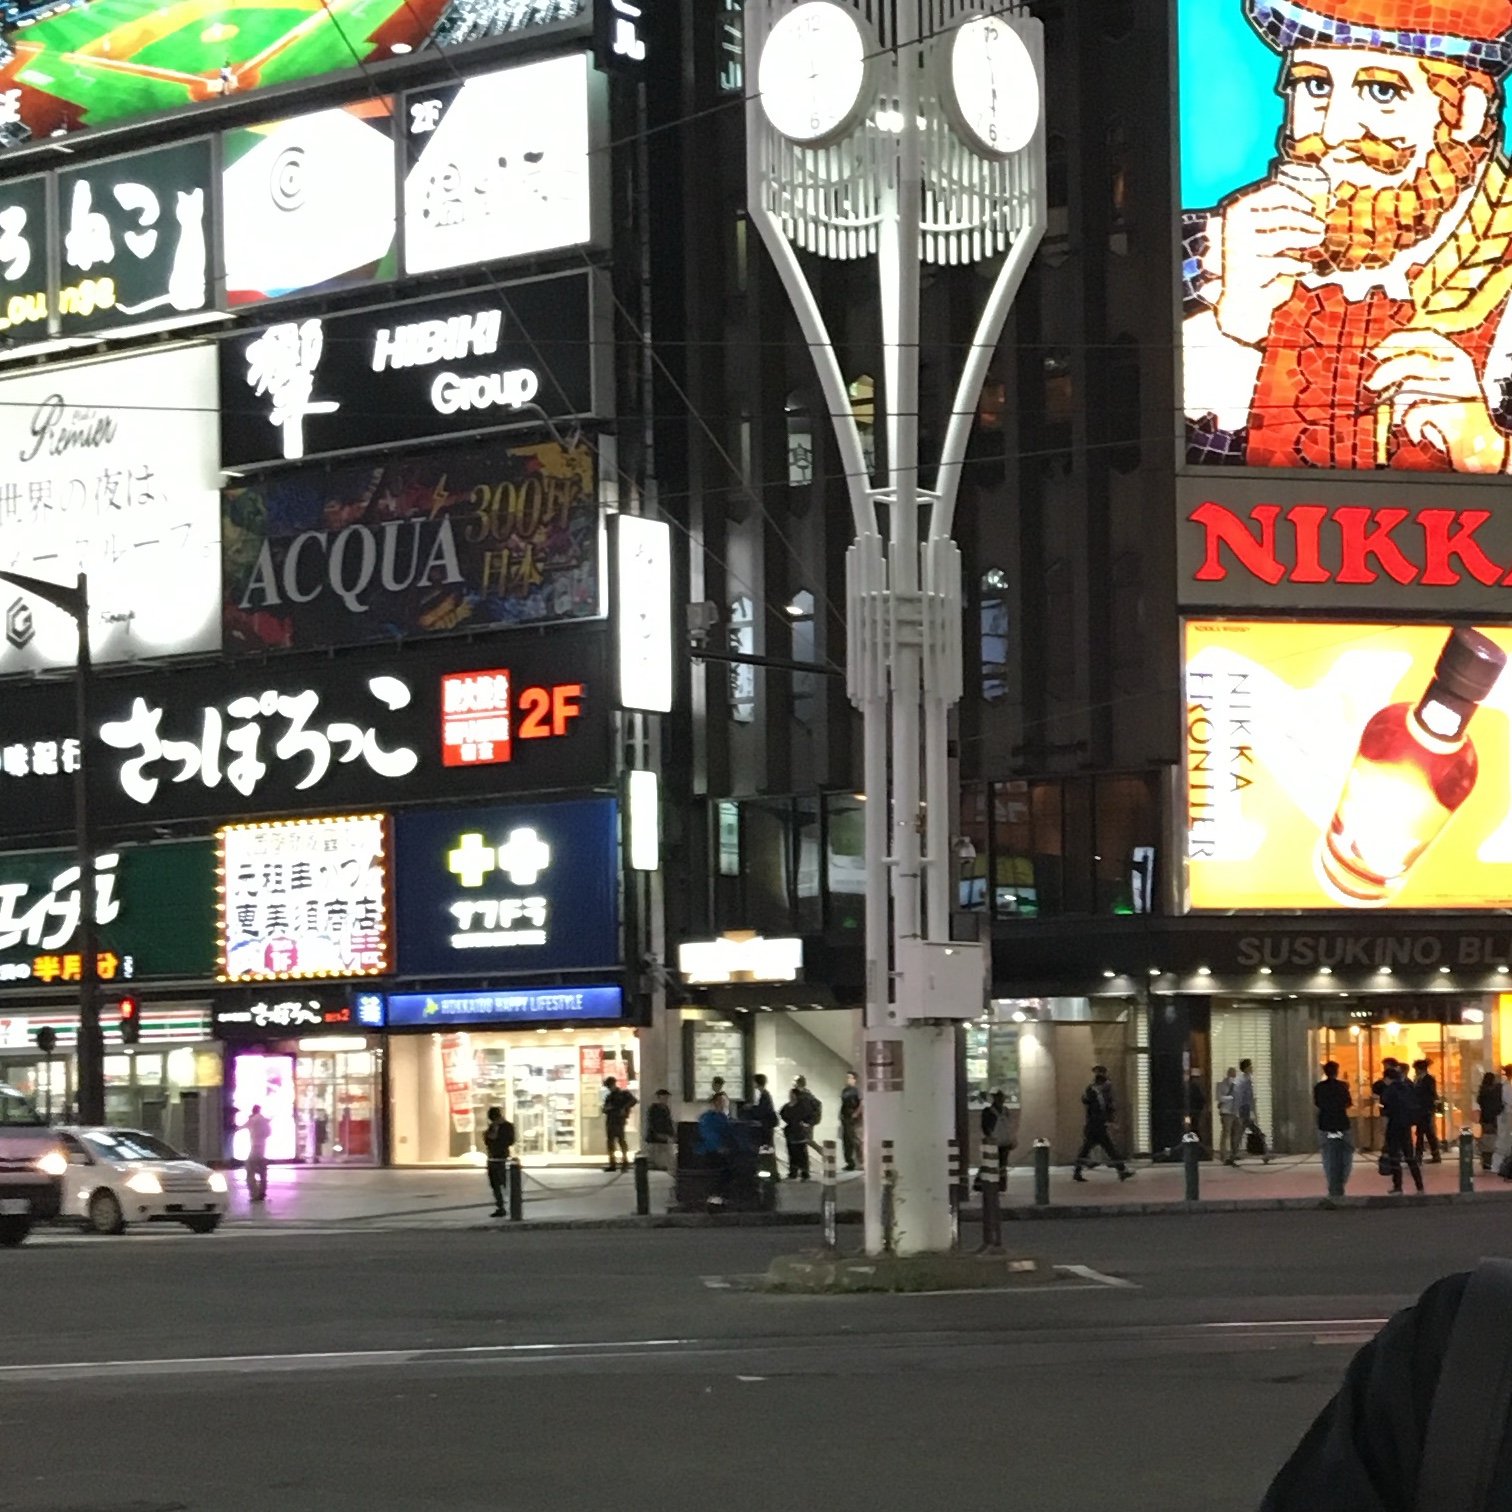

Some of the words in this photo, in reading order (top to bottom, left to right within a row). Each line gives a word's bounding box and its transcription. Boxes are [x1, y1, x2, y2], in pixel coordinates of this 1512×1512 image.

[410, 100, 442, 134] 2F
[372, 309, 501, 371] HIBIKI
[431, 368, 538, 414] Group
[238, 513, 465, 613] ACQUA
[518, 684, 581, 739] 2F
[1228, 672, 1254, 792] NIKKA
[99, 675, 418, 804] さっぽろっこ
[1237, 936, 1442, 967] SUSUKINO
[530, 994, 584, 1012] LIFESTYLE
